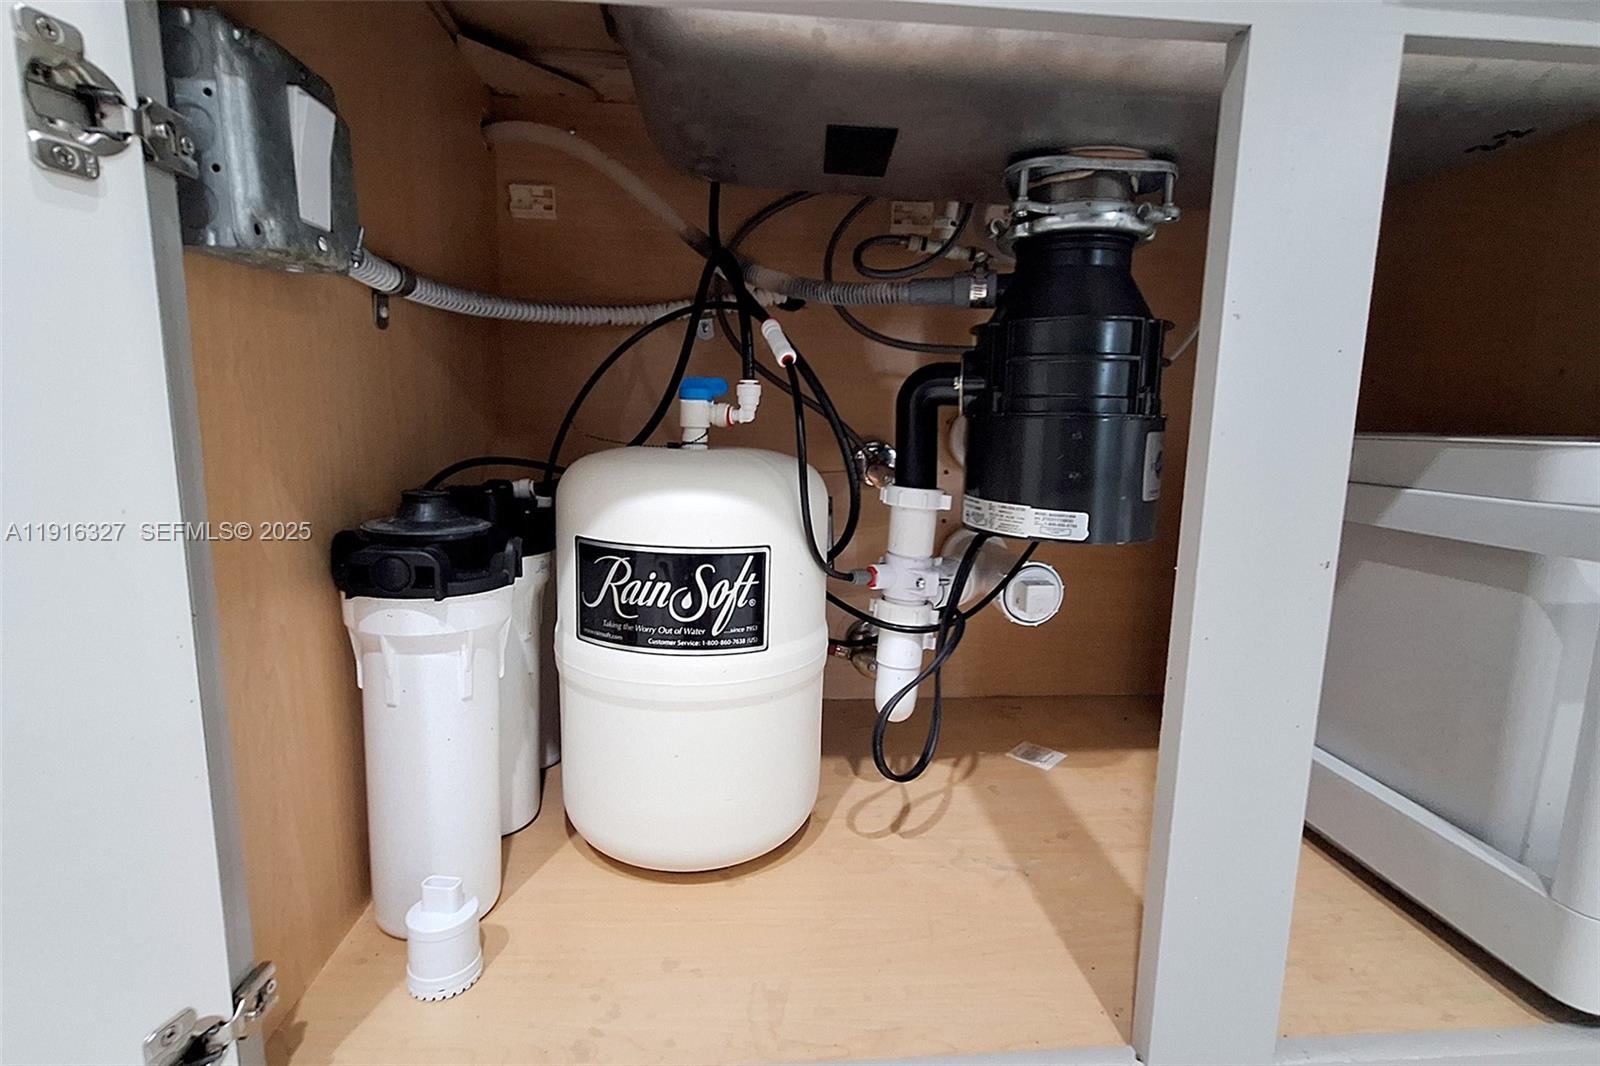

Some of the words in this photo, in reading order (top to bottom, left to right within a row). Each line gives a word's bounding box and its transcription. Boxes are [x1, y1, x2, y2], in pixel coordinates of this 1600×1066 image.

[603, 619, 622, 632] Taking
[623, 622, 634, 631] the
[635, 623, 656, 634] Worry
[658, 625, 672, 635] Out
[674, 625, 683, 635] of
[683, 626, 706, 636] Water
[648, 637, 676, 647] Customer
[677, 638, 700, 647] Service:
